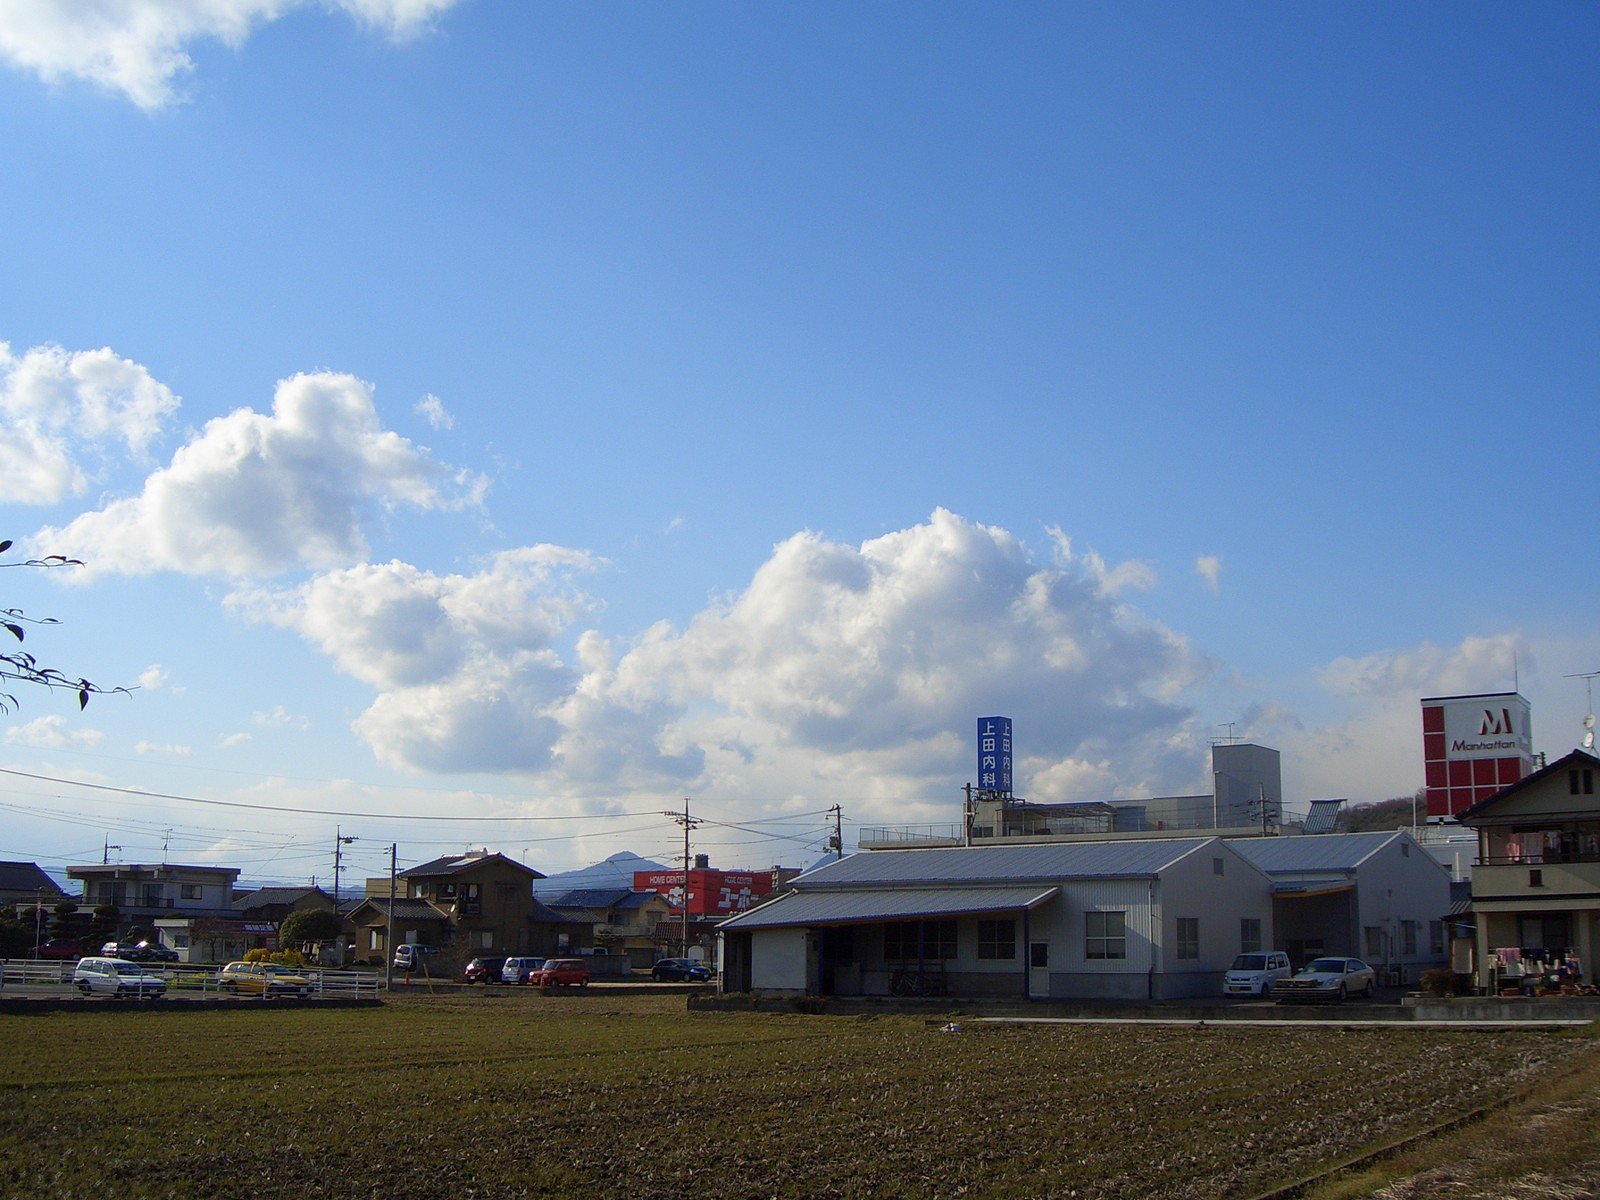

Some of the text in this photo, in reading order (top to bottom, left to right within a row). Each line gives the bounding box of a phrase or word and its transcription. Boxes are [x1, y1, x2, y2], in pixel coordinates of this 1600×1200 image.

[982, 721, 995, 787] 上田内科
[1002, 722, 1010, 787] 上田内科
[1451, 740, 1516, 752] Manhattan
[650, 875, 666, 884] HOME
[718, 887, 759, 908] ユーホー
